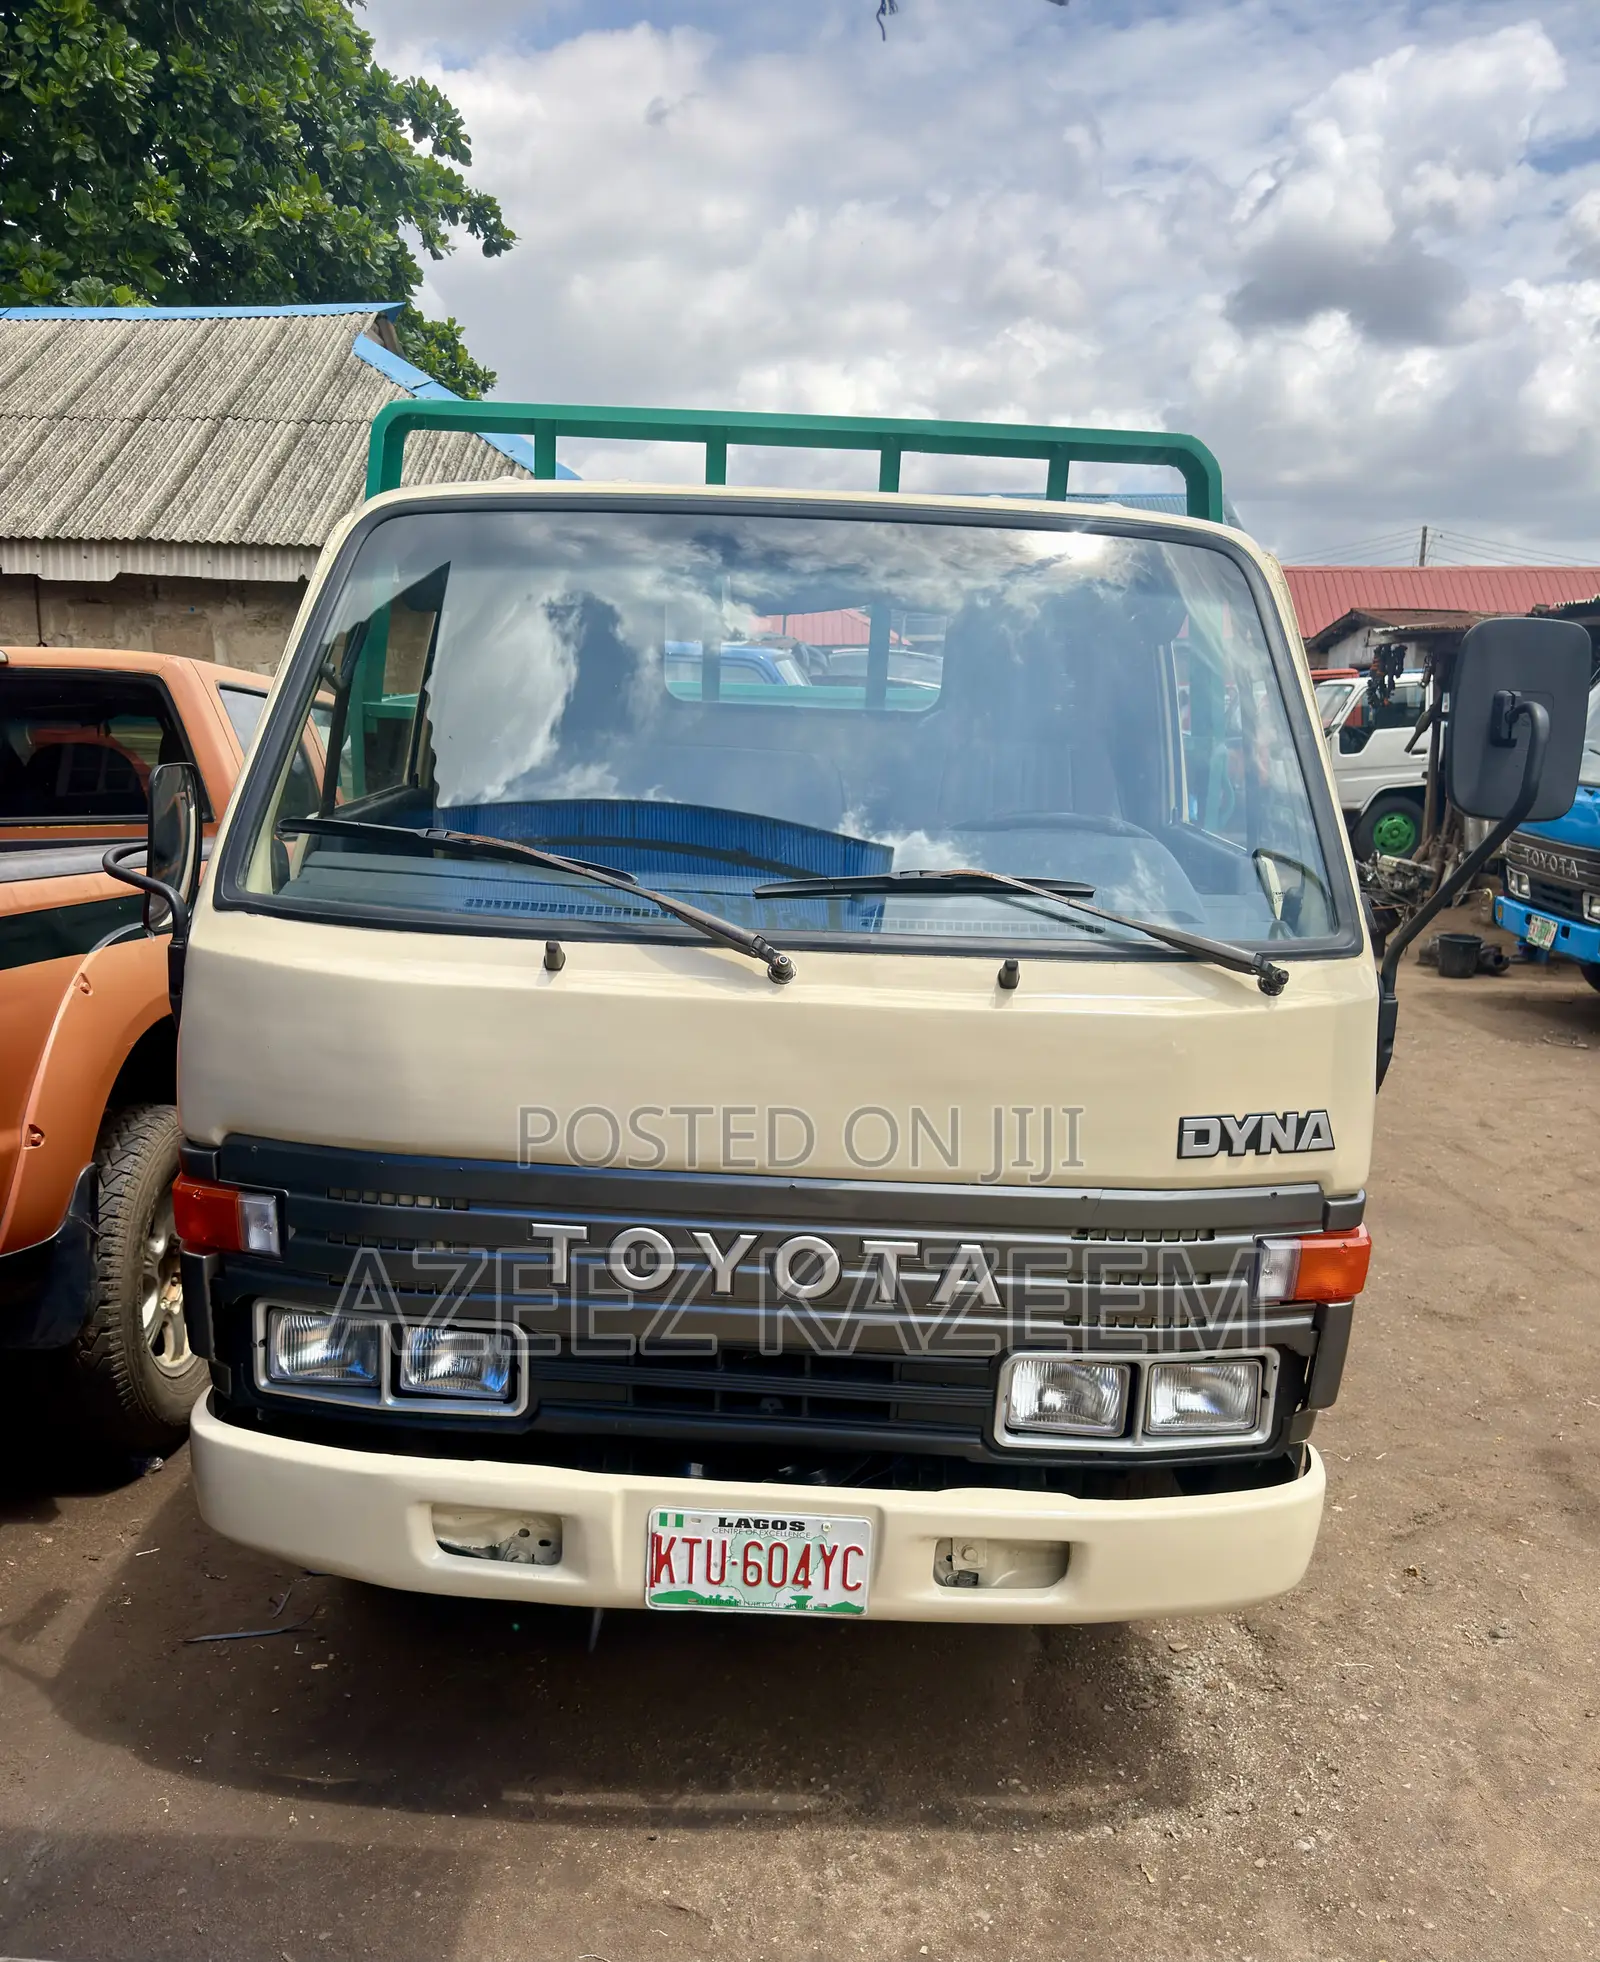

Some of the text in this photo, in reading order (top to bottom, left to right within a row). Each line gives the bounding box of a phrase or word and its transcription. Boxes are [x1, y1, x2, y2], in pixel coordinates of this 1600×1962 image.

[1524, 848, 1579, 878] TOYOTA
[1177, 1109, 1335, 1159] DYNA
[529, 1220, 1004, 1308] TOYOTA
[712, 1527, 741, 1535] CENTRE
[760, 1529, 811, 1538] EXCELLENCE
[717, 1516, 806, 1532] LAGOS
[653, 1533, 864, 1592] KTU-604YC
